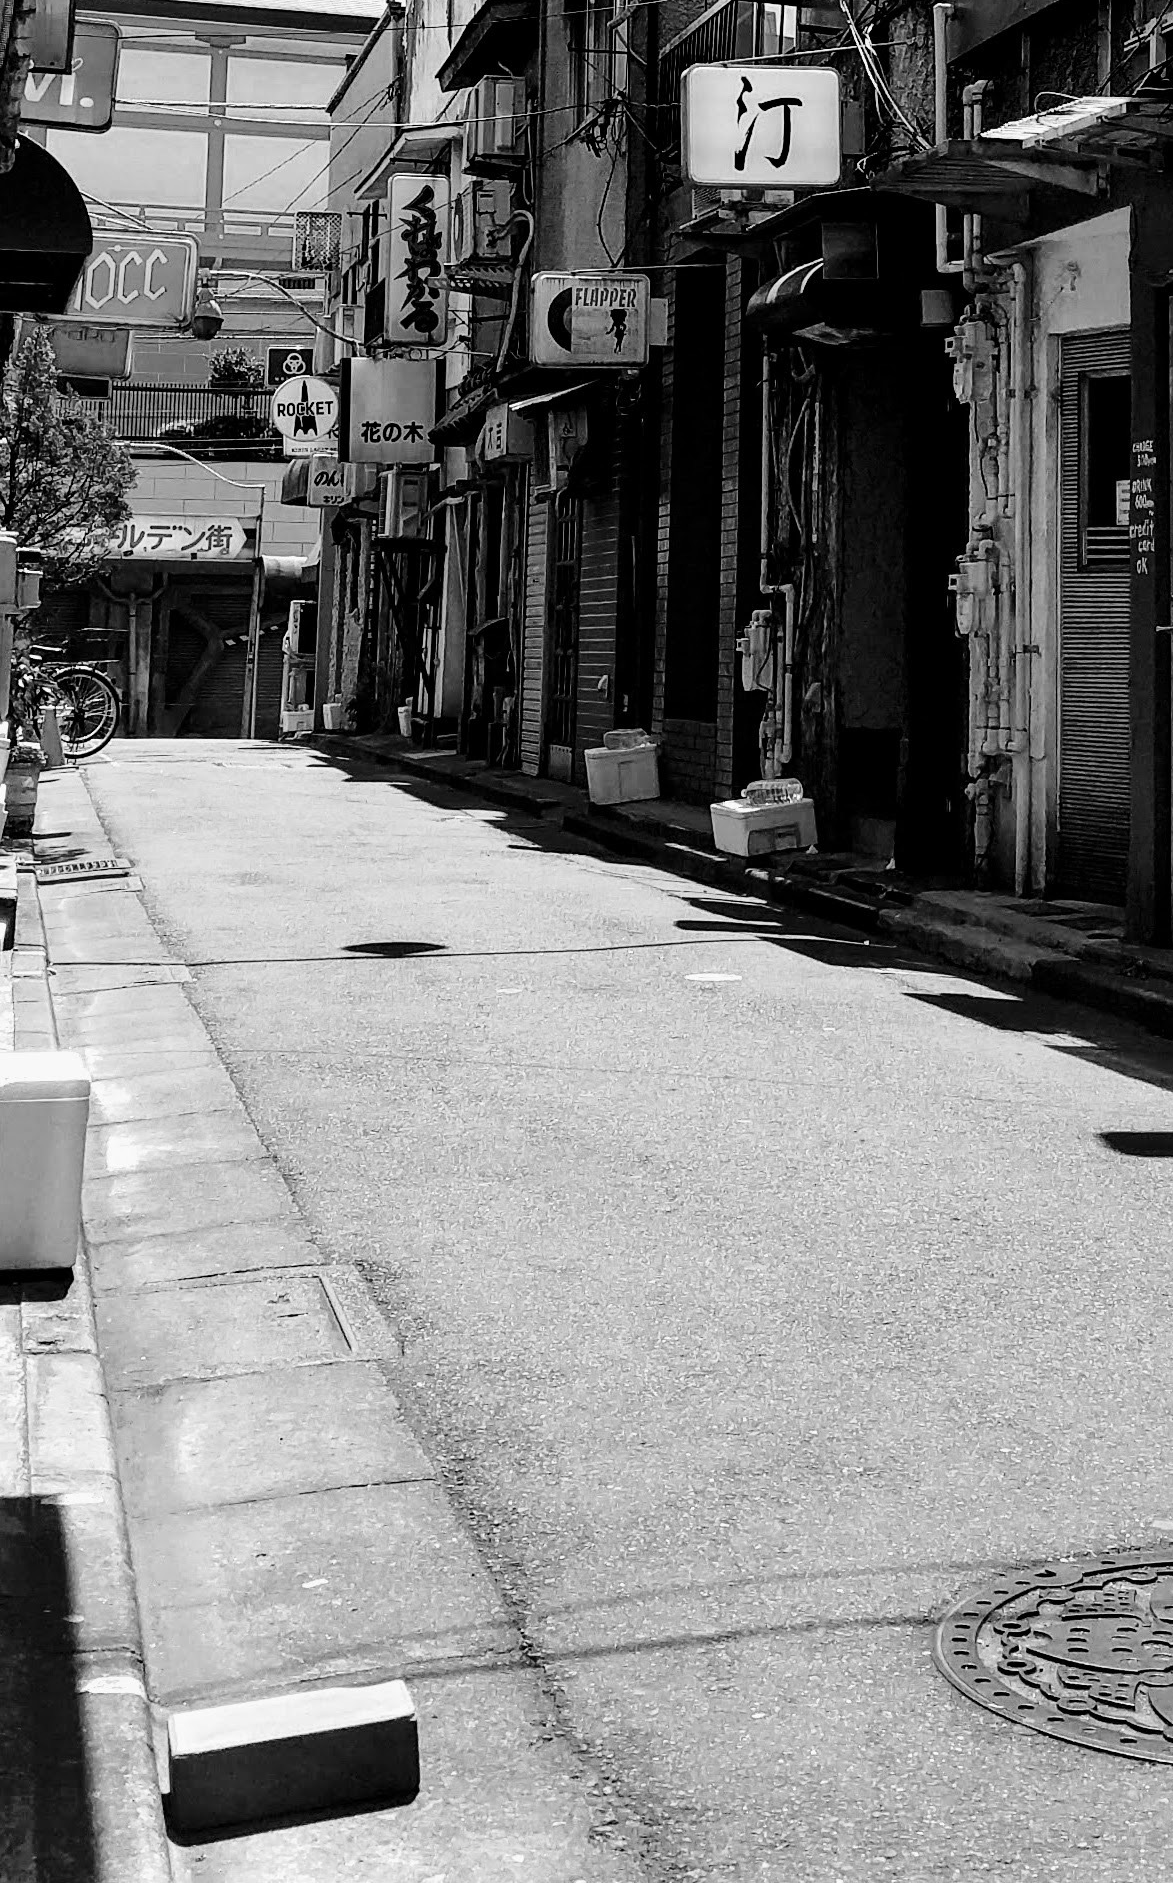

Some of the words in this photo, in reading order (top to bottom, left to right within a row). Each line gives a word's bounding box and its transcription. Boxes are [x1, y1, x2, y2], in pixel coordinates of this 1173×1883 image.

[575, 287, 637, 308] FLAPPER
[277, 401, 334, 417] ROCKET
[361, 421, 424, 443] 花の木
